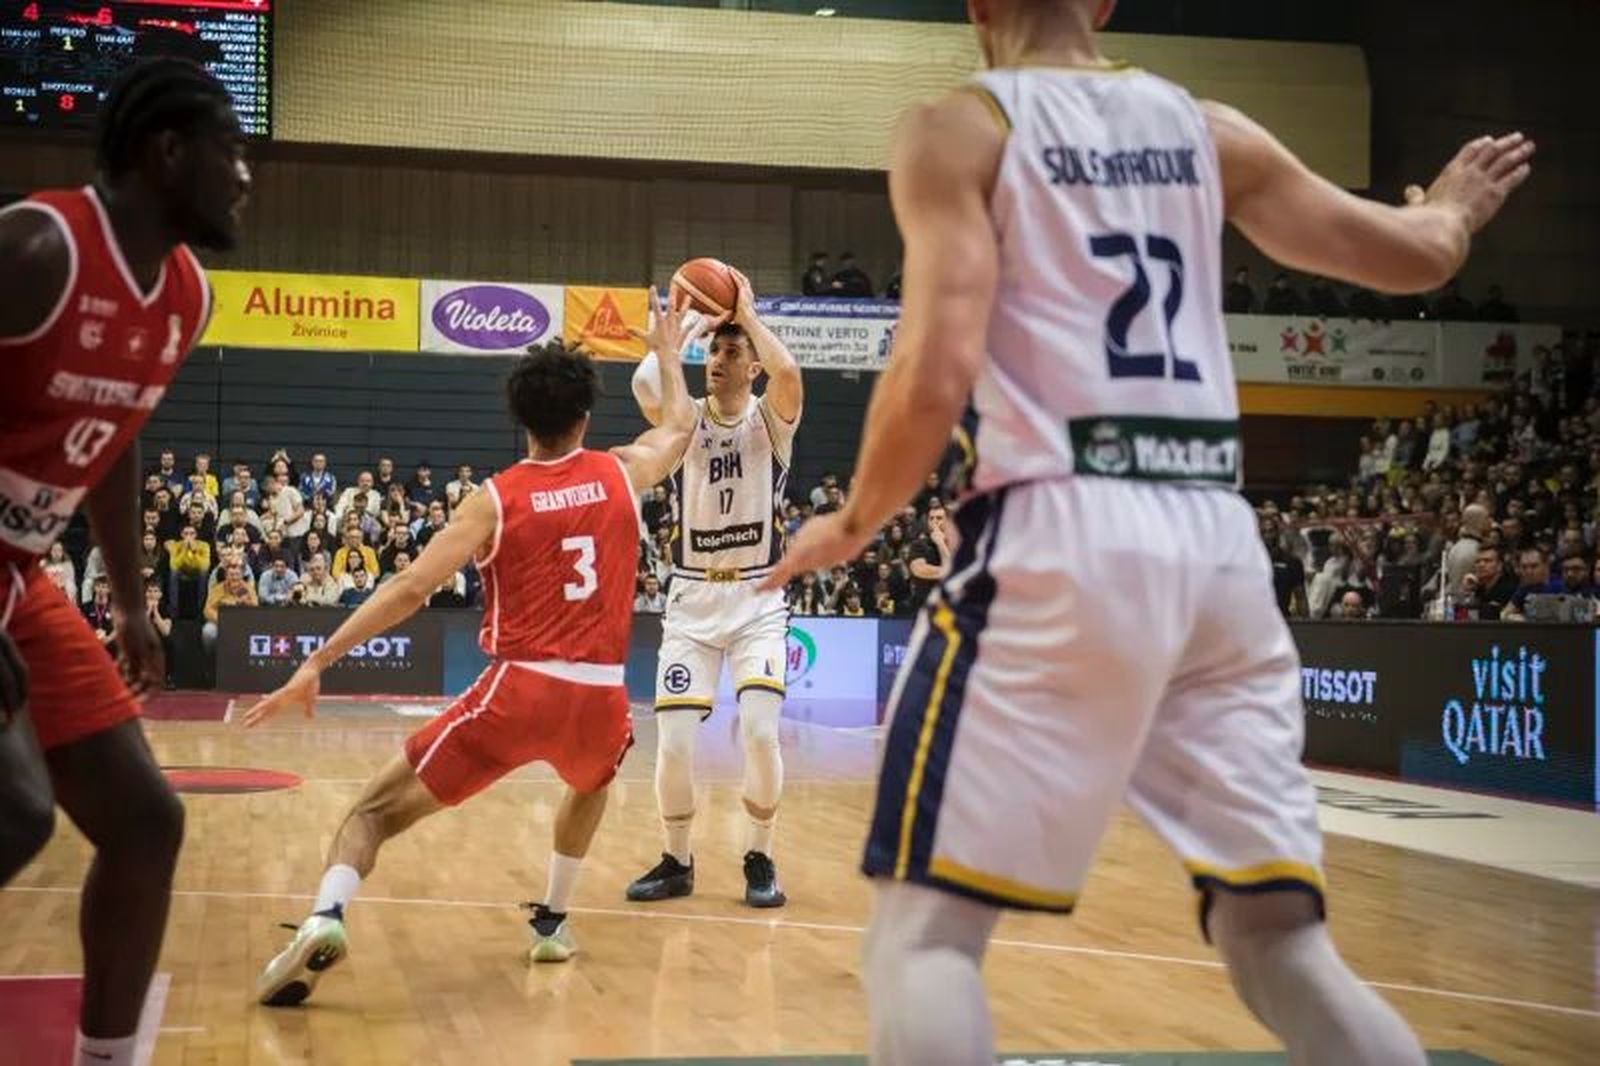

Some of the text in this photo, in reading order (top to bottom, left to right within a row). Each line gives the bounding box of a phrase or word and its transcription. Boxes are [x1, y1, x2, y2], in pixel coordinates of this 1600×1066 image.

[23, 3, 39, 21] 4
[50, 26, 87, 38] PERIOD
[62, 37, 73, 50] 1
[15, 99, 24, 112] 1
[59, 94, 75, 110] 8
[243, 287, 395, 322] Alumina
[445, 299, 538, 334] Violeta
[1089, 234, 1203, 383] 22
[827, 327, 869, 339] VERTO
[708, 451, 743, 484] BIH
[719, 487, 734, 515] 17
[561, 535, 598, 601] 3
[1301, 667, 1377, 703] TISSOT
[1471, 645, 1546, 702] visit
[1441, 699, 1545, 764] QATAR
